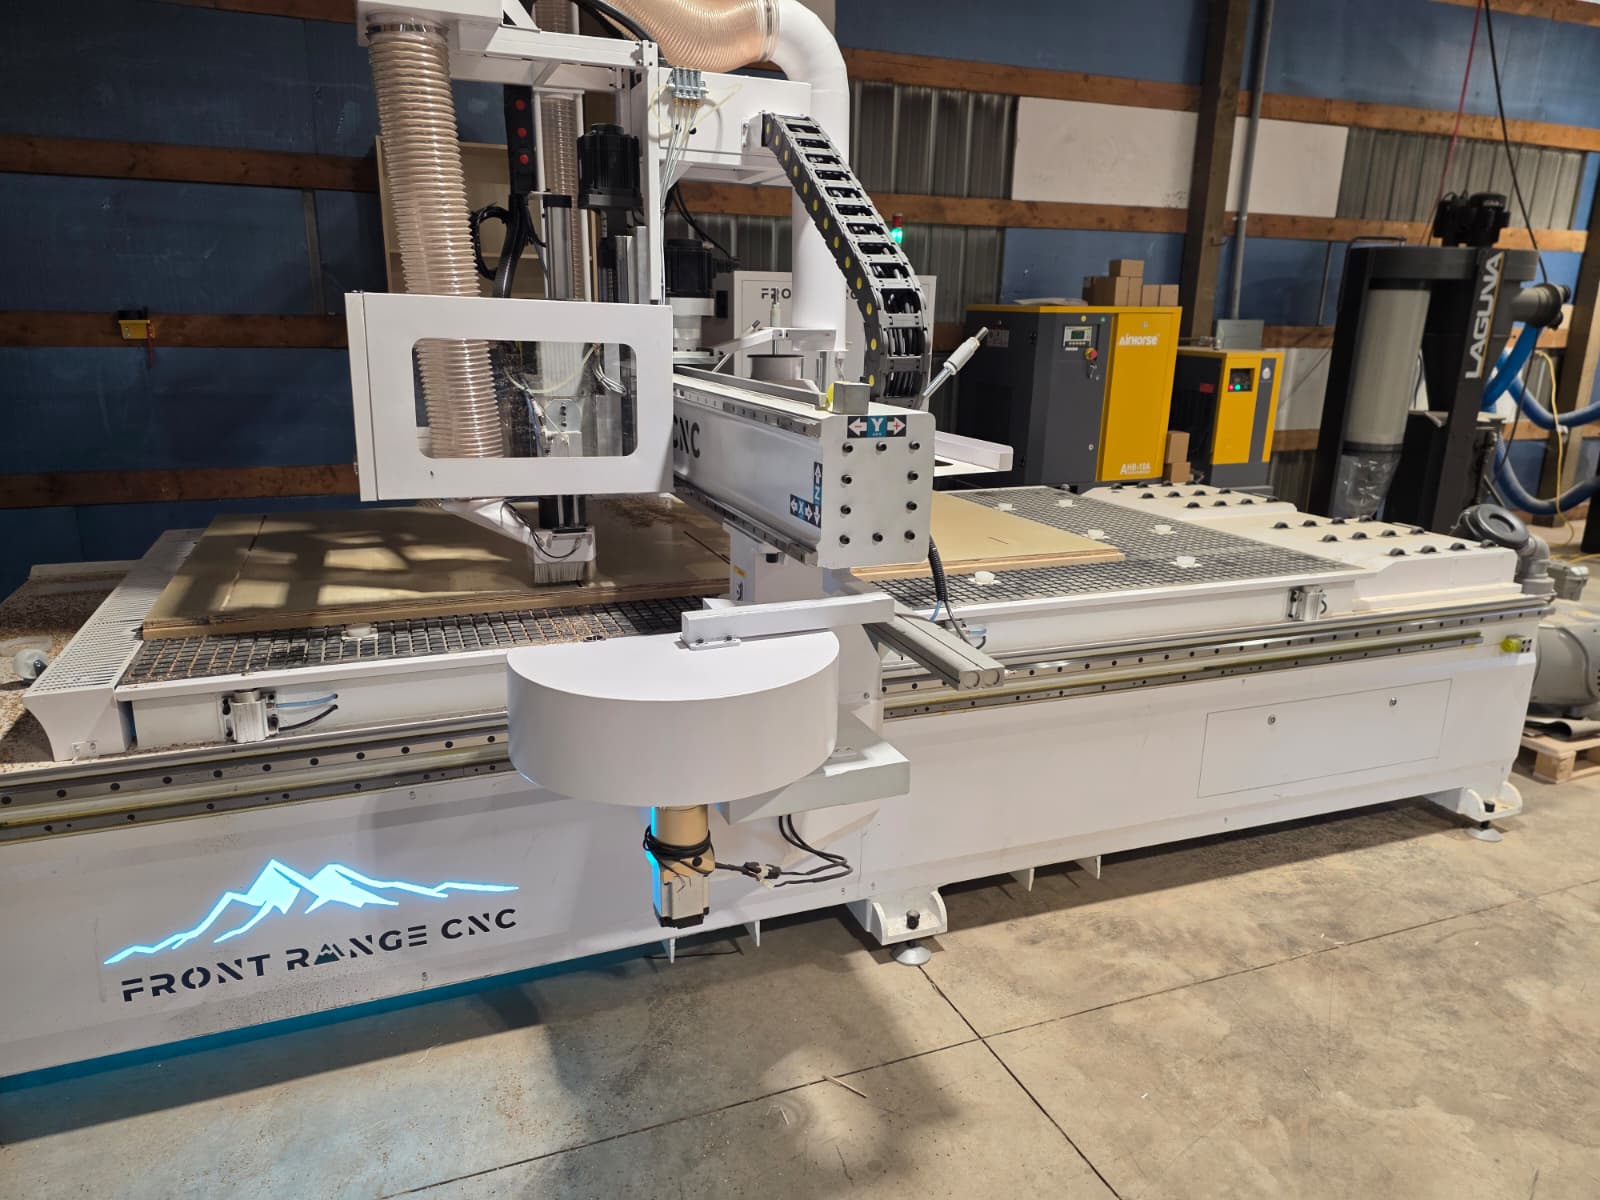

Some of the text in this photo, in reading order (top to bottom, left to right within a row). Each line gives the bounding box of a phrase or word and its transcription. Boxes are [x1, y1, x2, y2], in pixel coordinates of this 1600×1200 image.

[761, 287, 792, 300] FRO
[1465, 251, 1504, 378] LAGUNA
[870, 417, 884, 433] Y
[121, 908, 517, 1003] FRONT RANGE CNC
